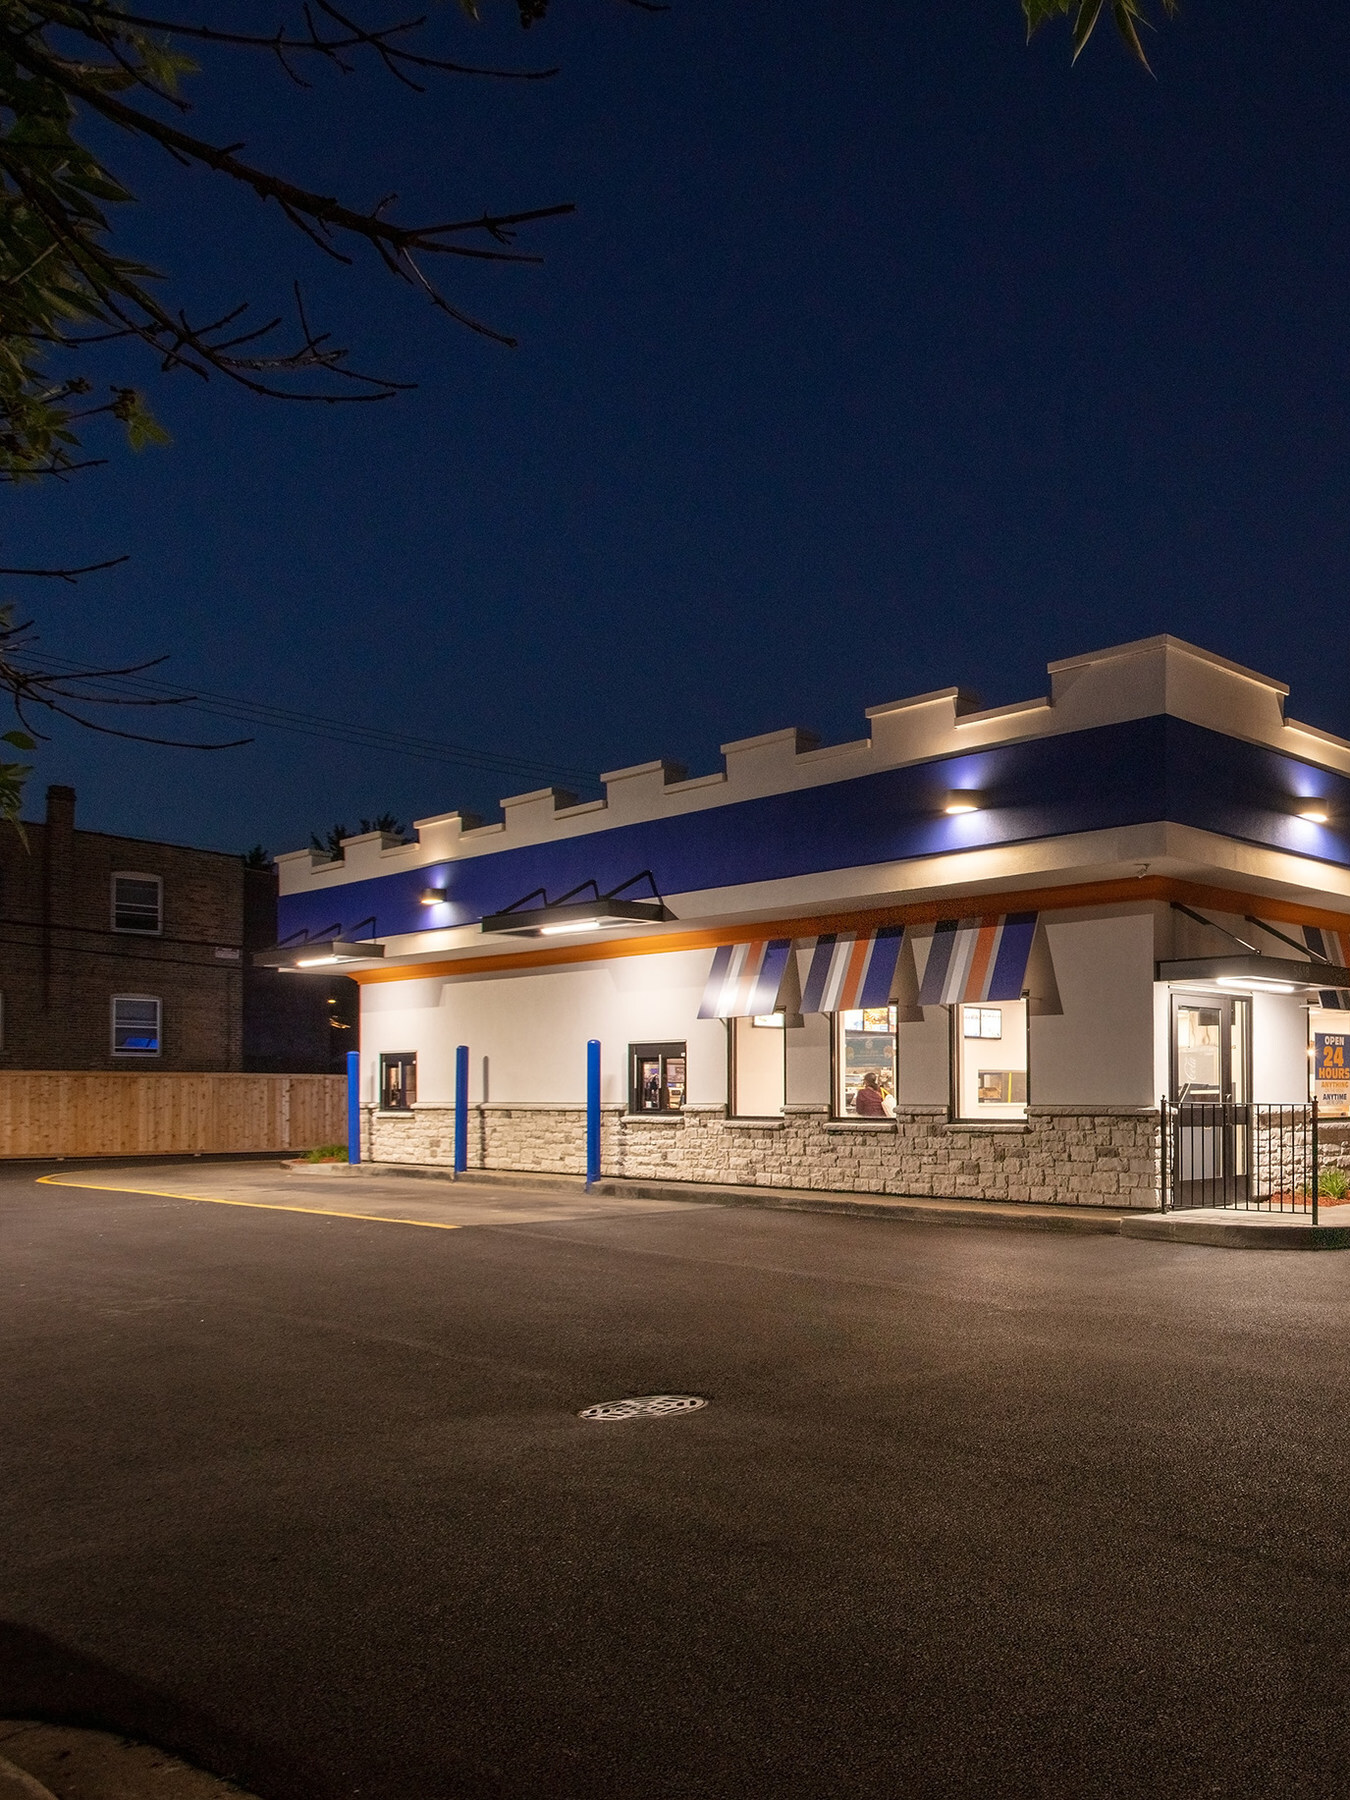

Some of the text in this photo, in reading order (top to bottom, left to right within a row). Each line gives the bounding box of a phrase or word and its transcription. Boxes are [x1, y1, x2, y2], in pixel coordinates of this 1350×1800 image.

[1324, 1035, 1345, 1046] OPEN
[1323, 1045, 1345, 1067] 24
[1318, 1067, 1350, 1079] HOURS
[1322, 1093, 1348, 1101] ANYTIME
